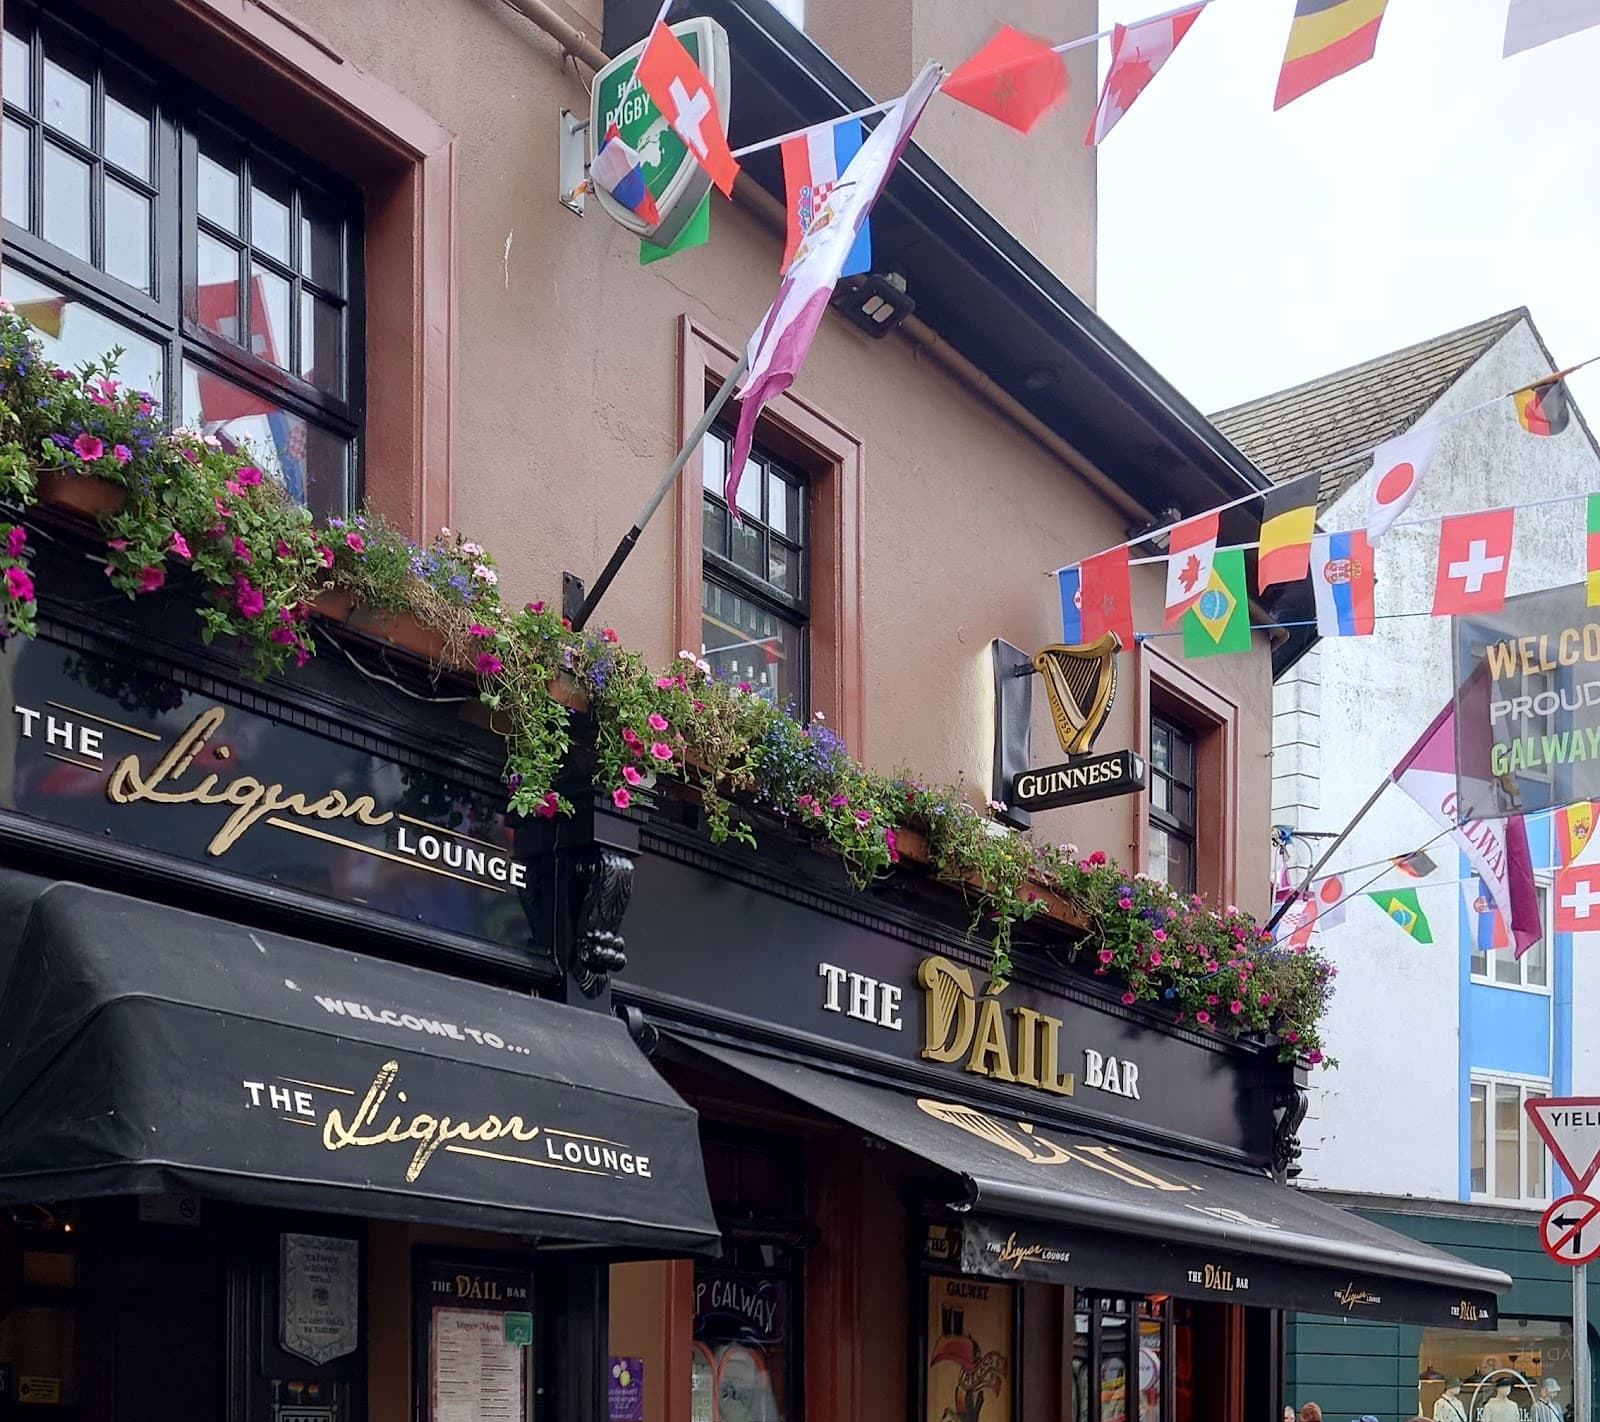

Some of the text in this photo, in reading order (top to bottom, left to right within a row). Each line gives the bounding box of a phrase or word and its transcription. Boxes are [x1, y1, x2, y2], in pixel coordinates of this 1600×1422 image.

[606, 92, 650, 133] RUGBY
[1057, 712, 1072, 734] 1759
[14, 704, 528, 889] THE Liquor LOUNGE
[1017, 758, 1123, 799] GUINNESS
[314, 993, 465, 1040] WELCOME
[819, 955, 1141, 1100] THE DÁIL BAR
[243, 1058, 653, 1184] THE Liquor LOUNGE
[1551, 1112, 1600, 1126] YIEL
[986, 1231, 1071, 1271] THE Liquor LOUNGE
[431, 1274, 528, 1300] THE DÁIL BAR
[946, 1280, 990, 1301] GALWAY
[1188, 1263, 1249, 1292] THE DÁIL BAR
[711, 1279, 777, 1333] GALWAY
